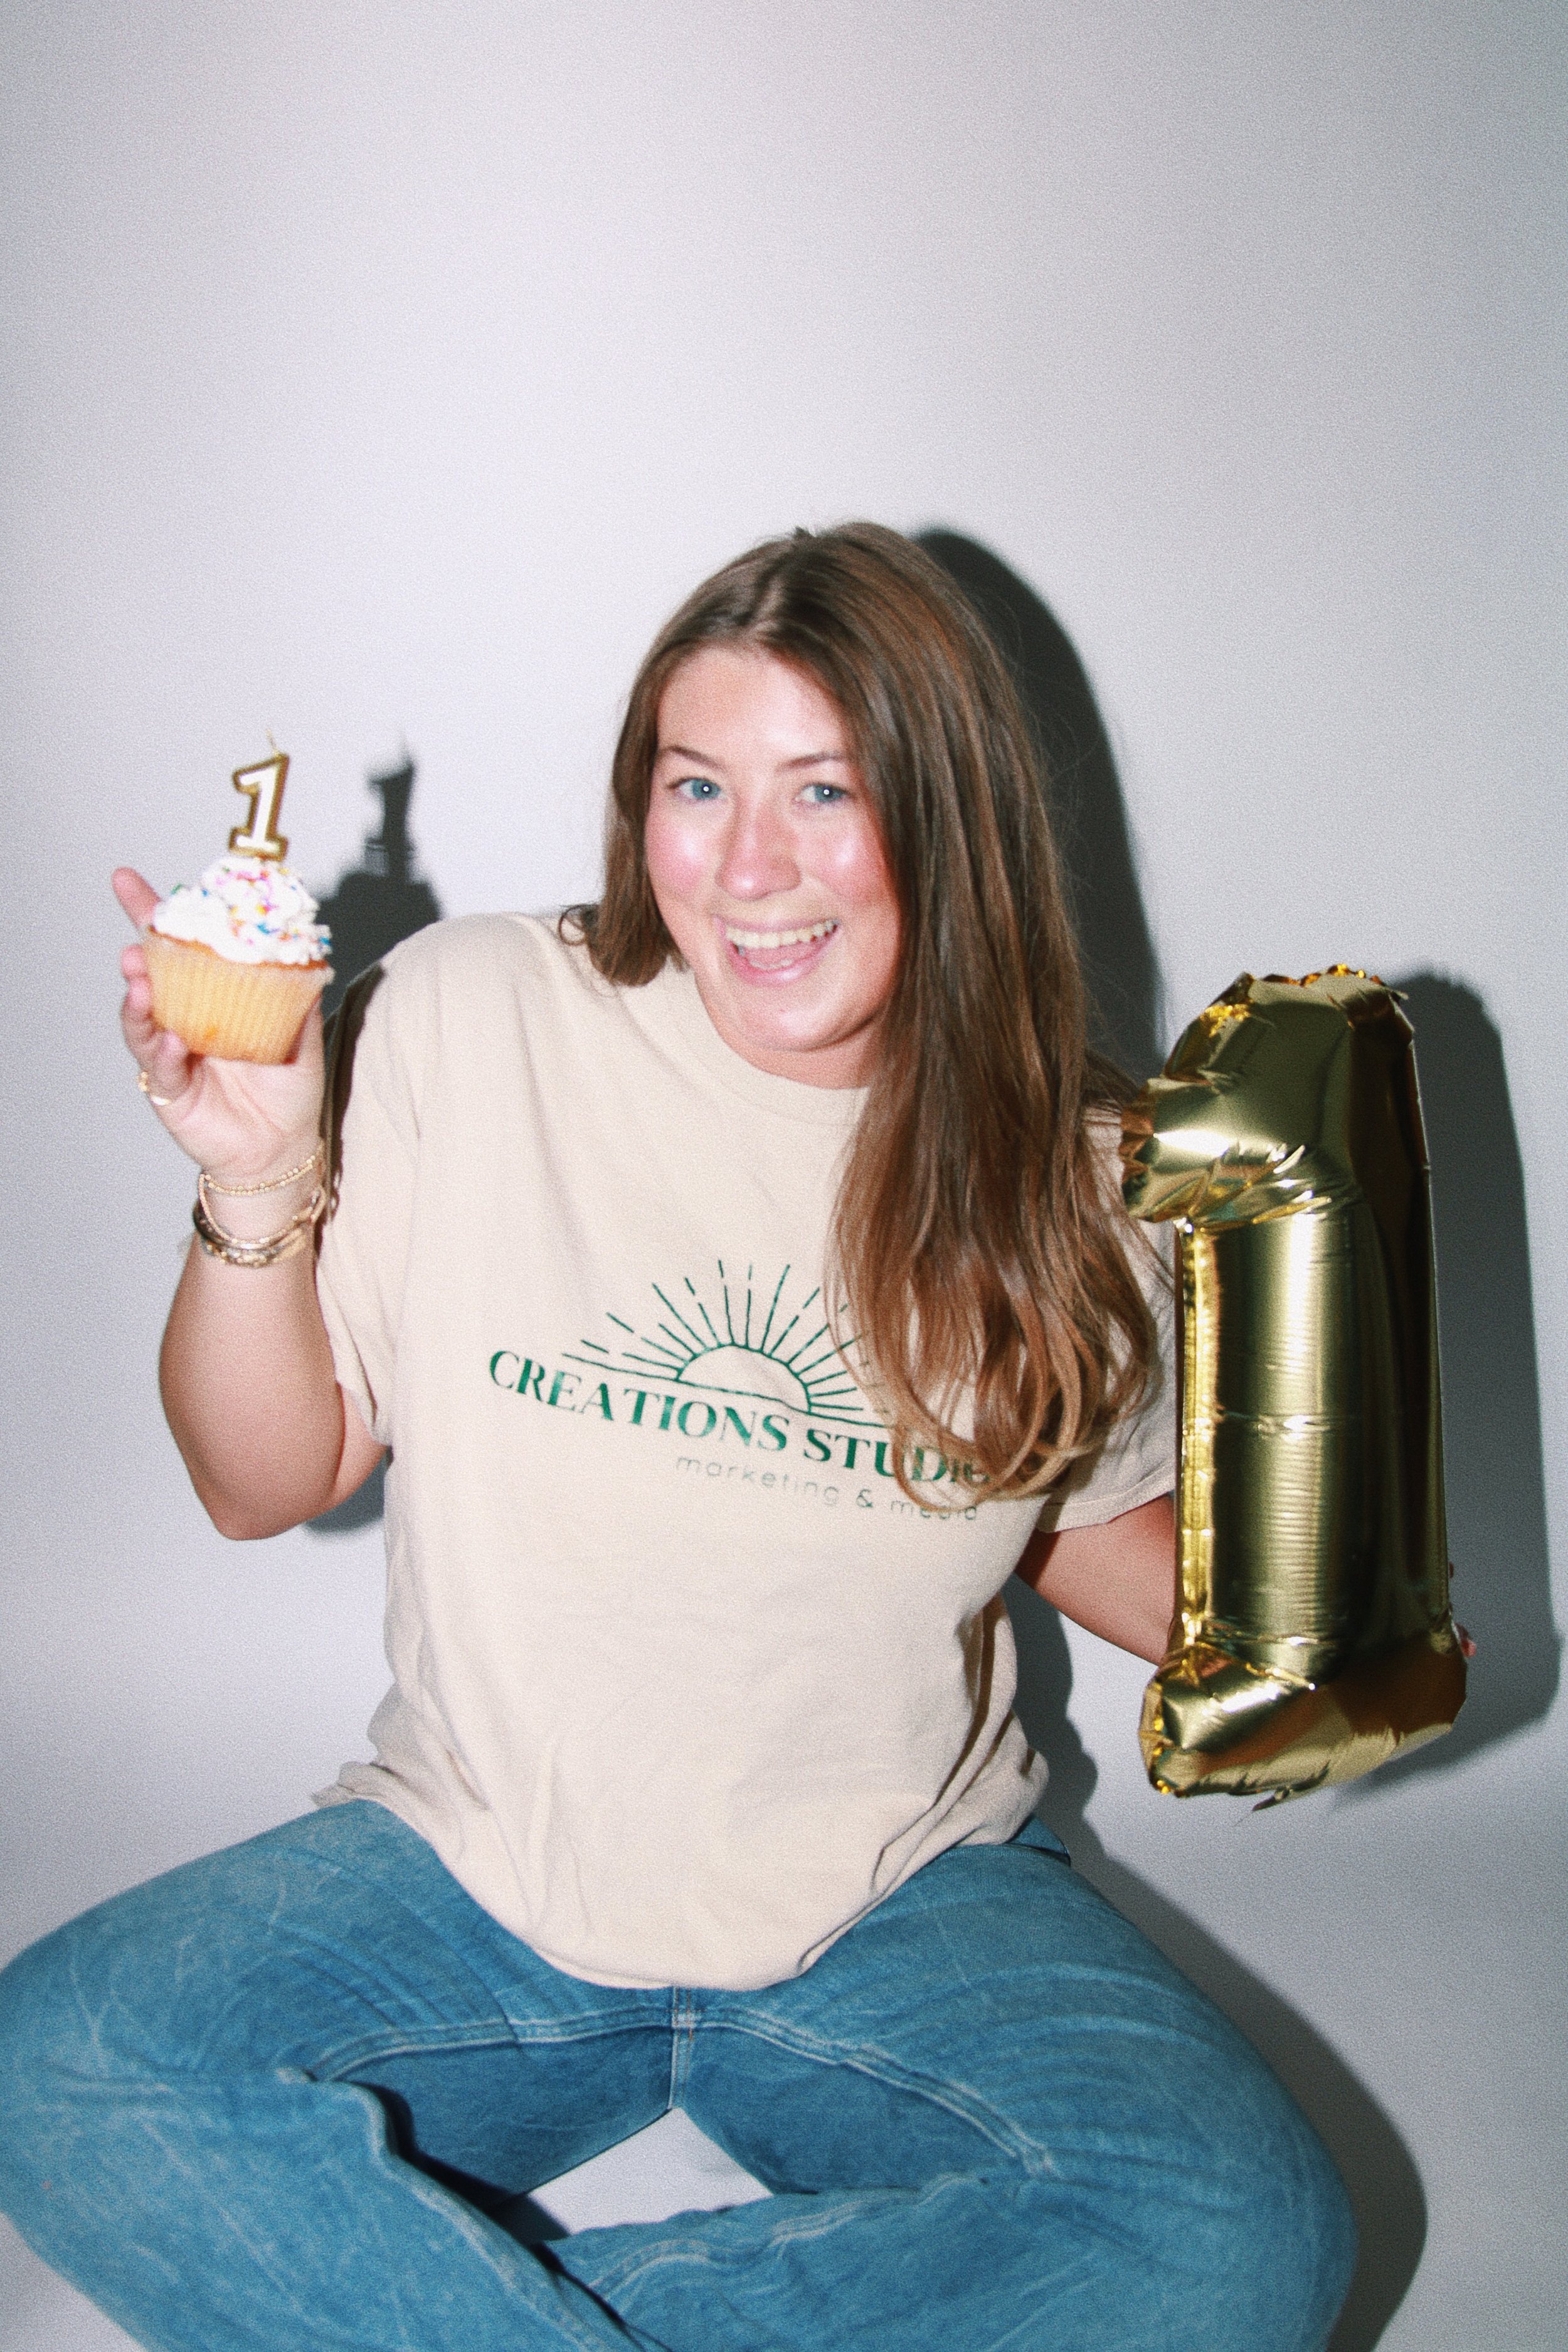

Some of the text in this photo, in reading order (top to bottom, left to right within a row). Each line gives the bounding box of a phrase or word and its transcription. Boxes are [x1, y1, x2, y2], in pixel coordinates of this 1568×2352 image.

[228, 752, 290, 861] 1
[489, 1350, 790, 1452] CREATIONS
[676, 1456, 839, 1506] marketing
[856, 1488, 873, 1508] &
